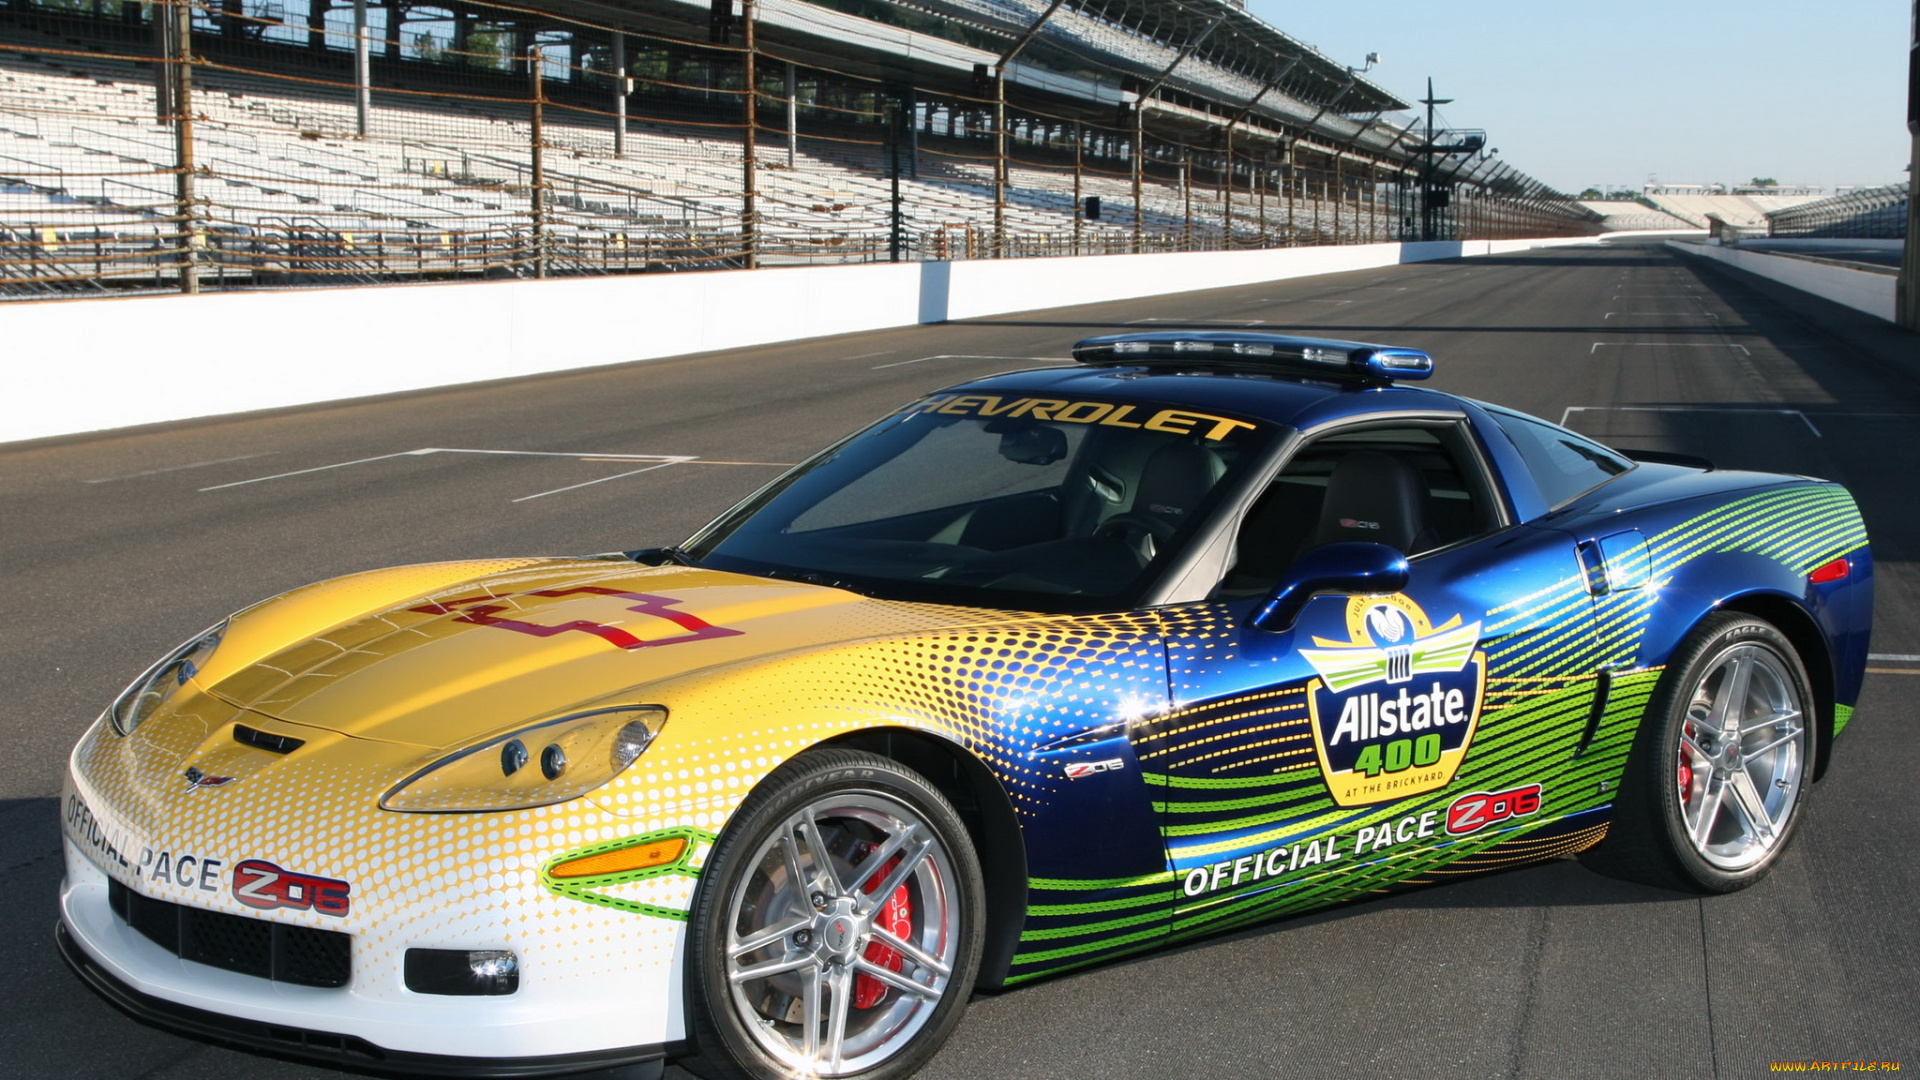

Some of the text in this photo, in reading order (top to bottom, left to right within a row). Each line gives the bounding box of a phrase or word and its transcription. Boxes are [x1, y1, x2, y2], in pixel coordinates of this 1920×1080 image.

[900, 395, 1256, 441] HEVROLET
[1353, 597, 1366, 618] JULY
[1725, 626, 1768, 641] EAGLE
[1329, 681, 1464, 746] Allstate
[1063, 758, 1125, 778] Z06
[1353, 732, 1441, 777] 400
[1345, 771, 1444, 798] AT THE BRICKYARD
[67, 793, 351, 919] OFFICIAL PACE Z06
[1183, 783, 1543, 897] OFFICIAL PACE Z06
